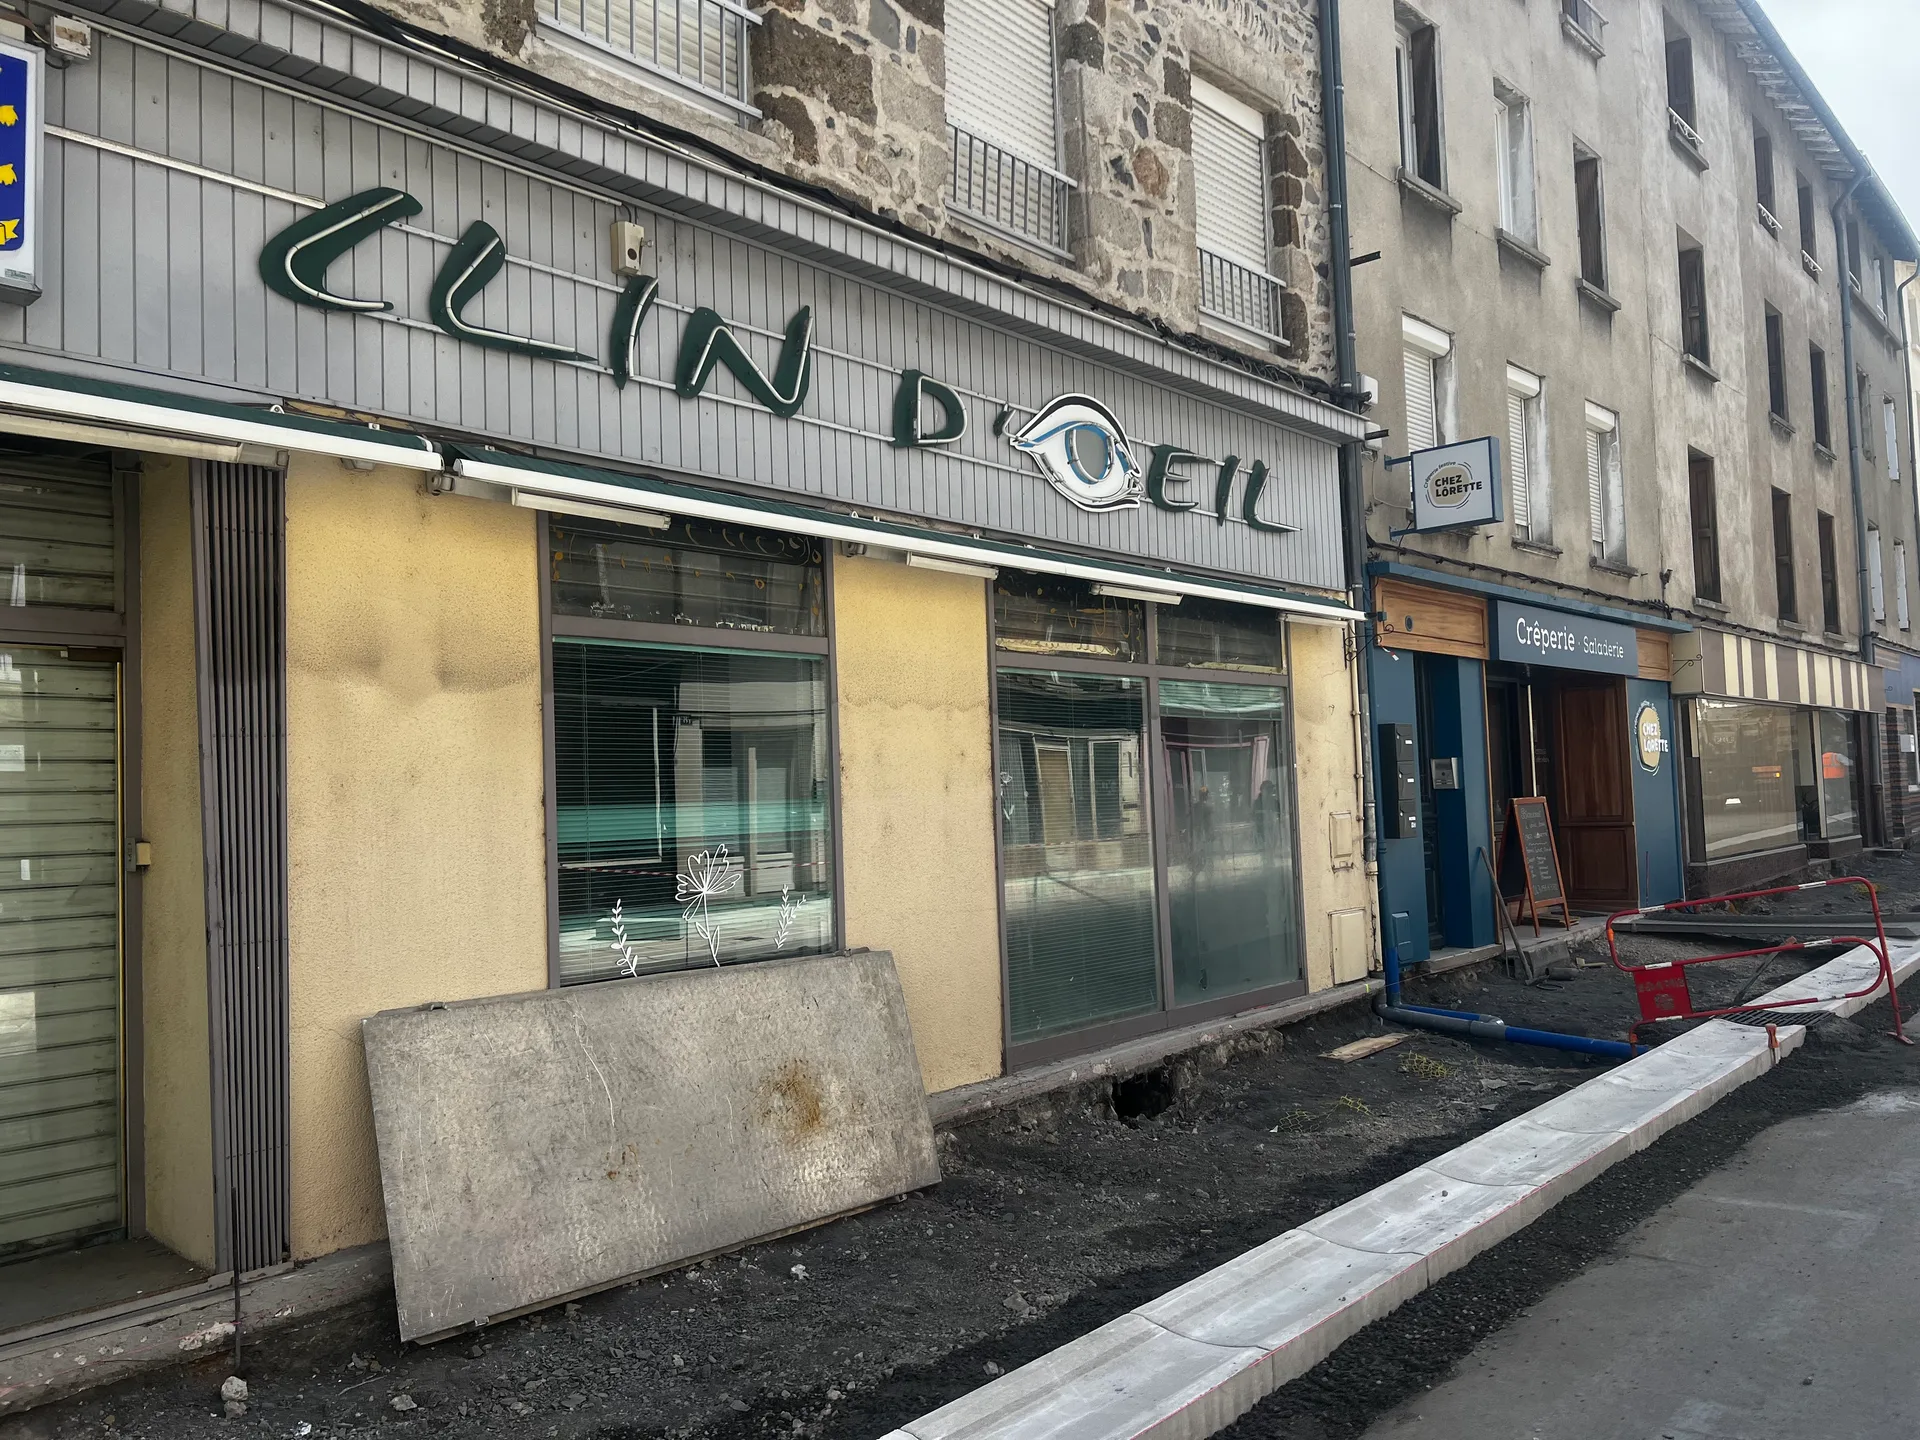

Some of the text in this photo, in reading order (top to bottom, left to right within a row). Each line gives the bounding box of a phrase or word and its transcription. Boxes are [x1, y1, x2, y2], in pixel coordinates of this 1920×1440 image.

[259, 187, 811, 418] CLIN
[1434, 474, 1463, 488] CHEZ
[1435, 481, 1483, 498] LÔRETTE
[1516, 617, 1624, 659] Crêperie Saladerie
[1642, 721, 1658, 737] CHEZ
